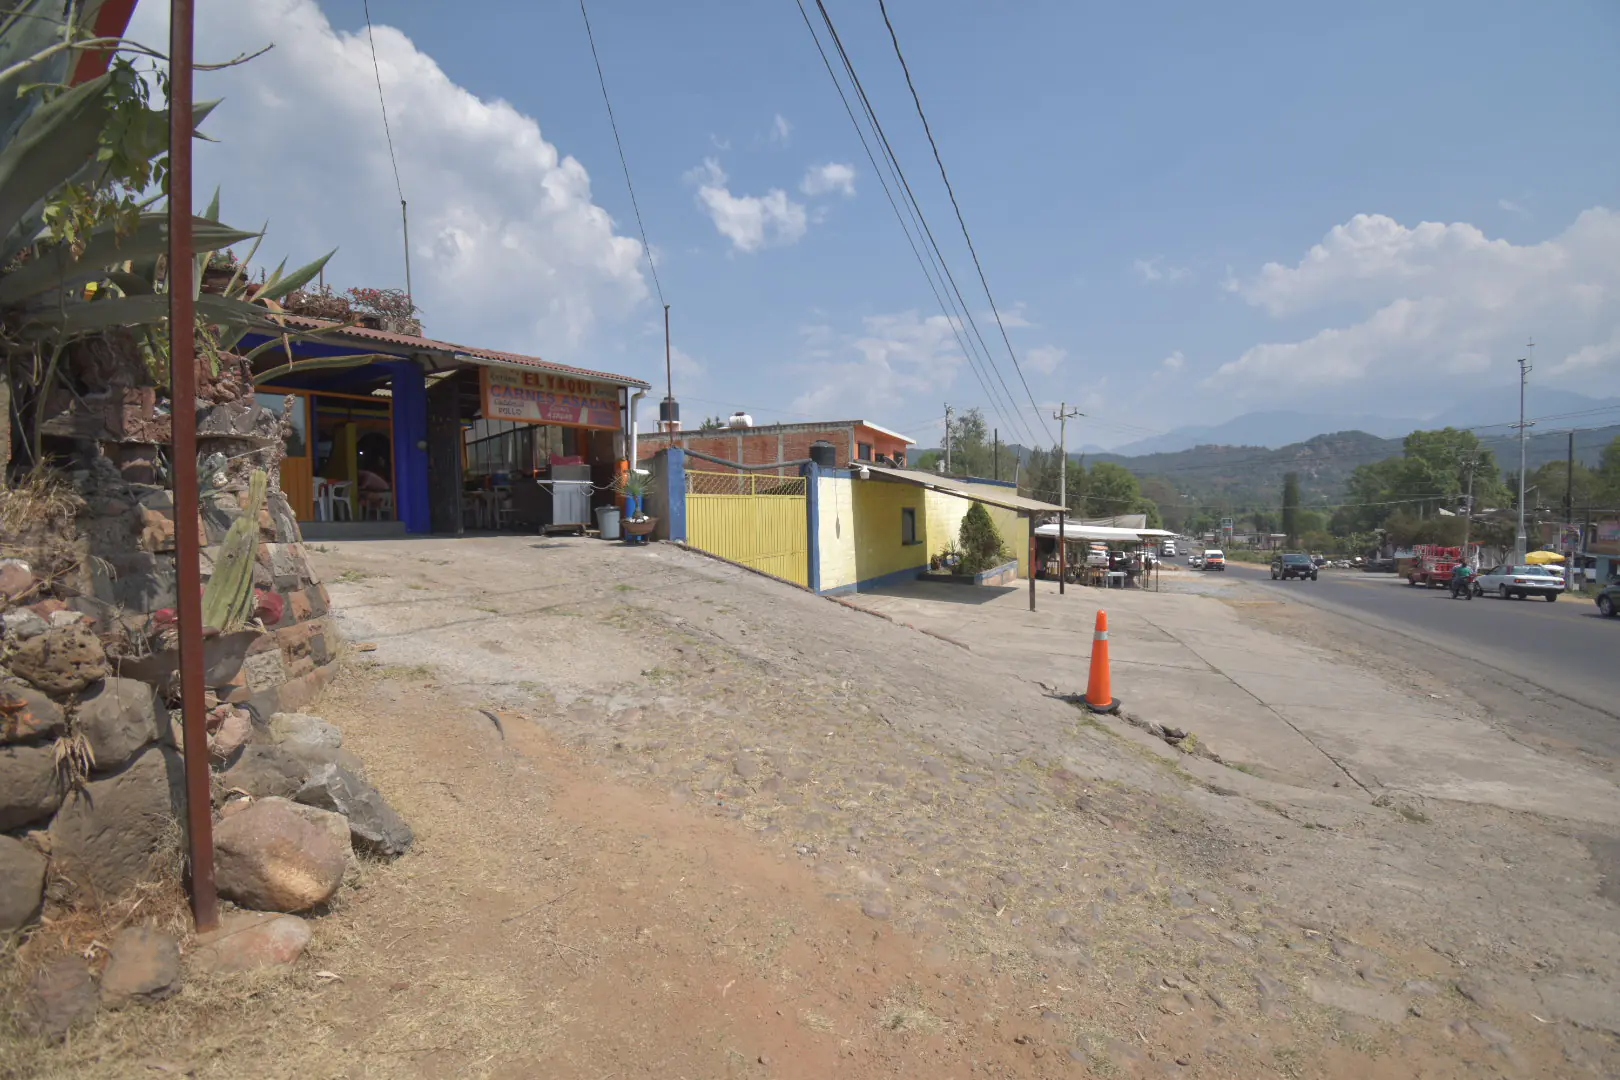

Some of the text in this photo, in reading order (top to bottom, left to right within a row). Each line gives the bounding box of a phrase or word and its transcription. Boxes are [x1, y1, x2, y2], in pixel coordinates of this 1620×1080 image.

[524, 372, 543, 386] EL
[492, 384, 555, 403] CARNES
[562, 394, 616, 411] ASADAS
[498, 407, 523, 416] POLLO
